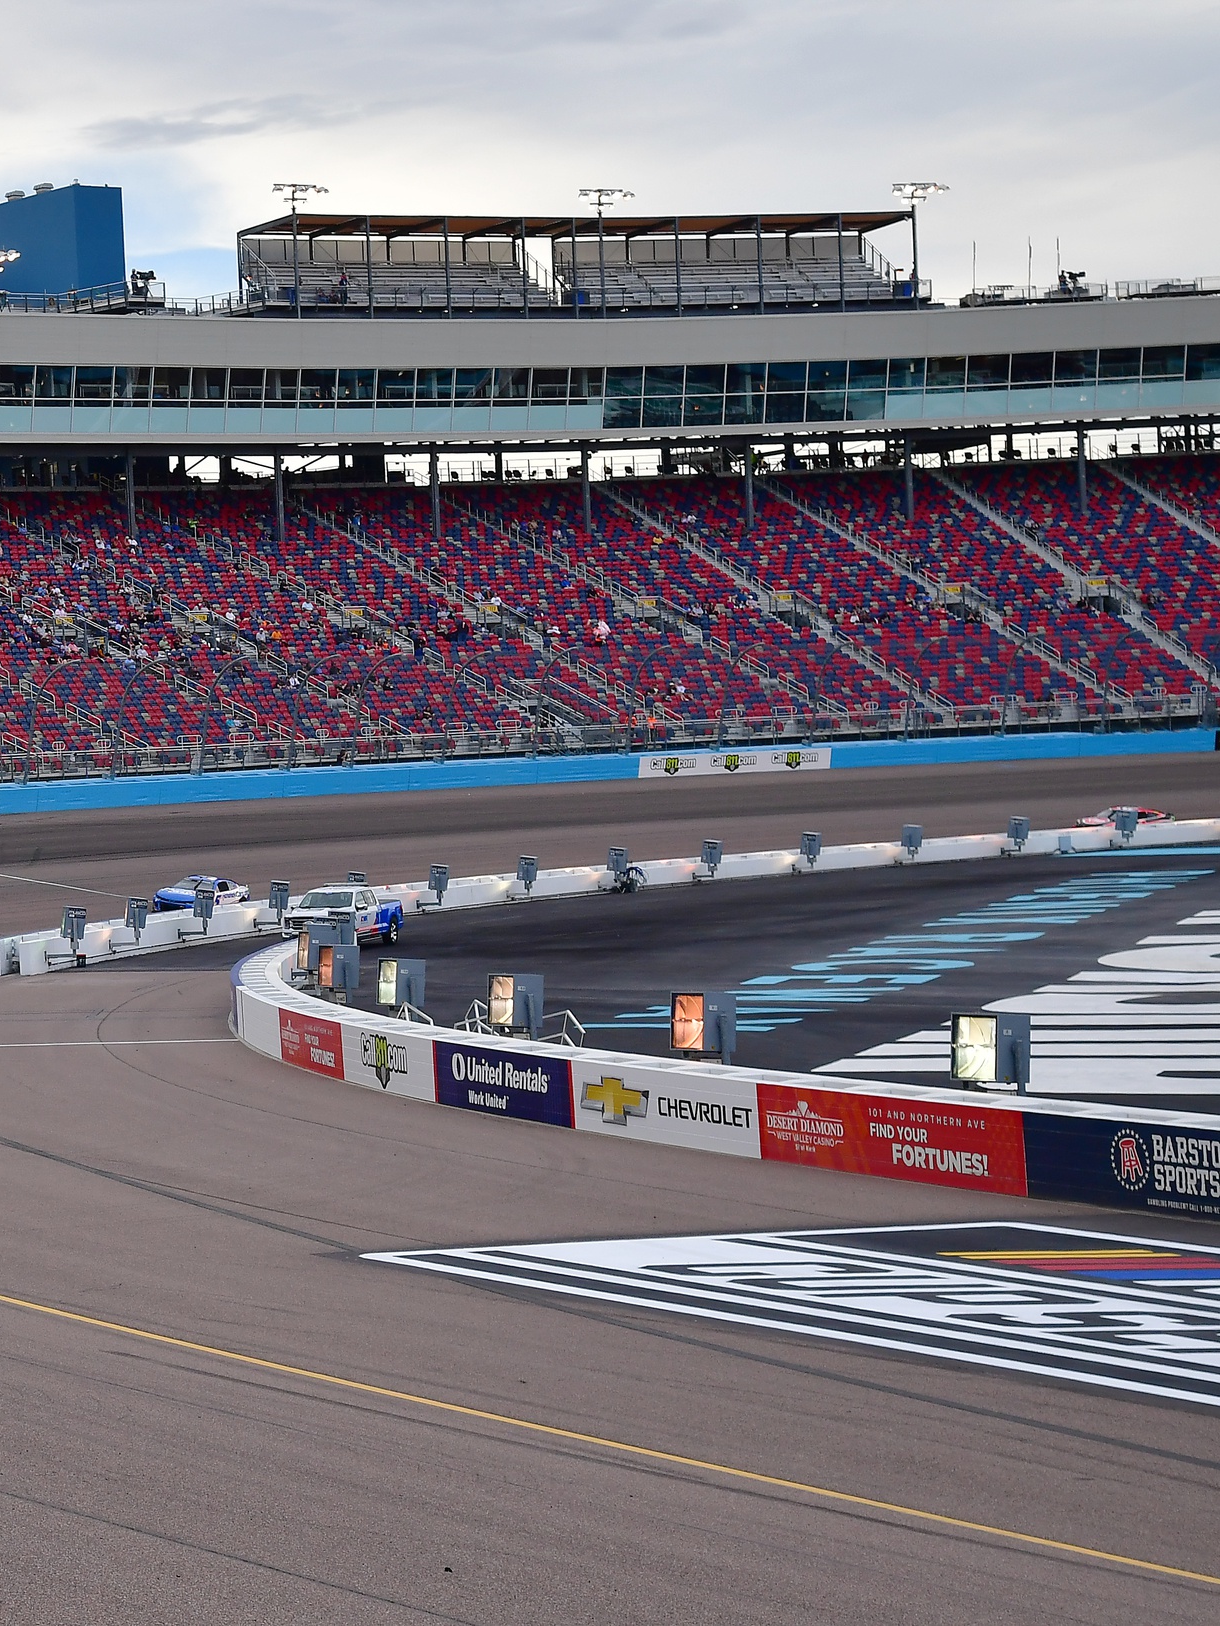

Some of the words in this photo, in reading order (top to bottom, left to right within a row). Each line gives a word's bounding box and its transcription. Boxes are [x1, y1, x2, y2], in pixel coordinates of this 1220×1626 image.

[650, 757, 697, 773] Call811.com
[710, 754, 757, 770] Call811.com
[771, 751, 819, 767] Call811.com
[360, 1031, 408, 1075] Call811.com
[467, 1054, 504, 1087] United
[505, 1062, 548, 1094] Rentals
[468, 1089, 484, 1107] Work
[485, 1092, 508, 1110] United
[657, 1096, 753, 1129] CHEVROLET
[868, 1108, 883, 1118] 101
[887, 1110, 905, 1121] AND
[910, 1112, 962, 1127] NORTHERN
[967, 1119, 986, 1130] AVE
[766, 1114, 798, 1131] DESERT
[799, 1118, 844, 1137] DIAMOND
[869, 1122, 895, 1139] FIND
[896, 1126, 928, 1143] YOUR
[776, 1131, 792, 1141] WEST
[793, 1133, 813, 1145] VALLEY
[813, 1136, 835, 1148] CASINO
[892, 1143, 989, 1177] FORTUNES!
[1154, 1163, 1220, 1198] SPORTS
[642, 1261, 1100, 1306] CUP
